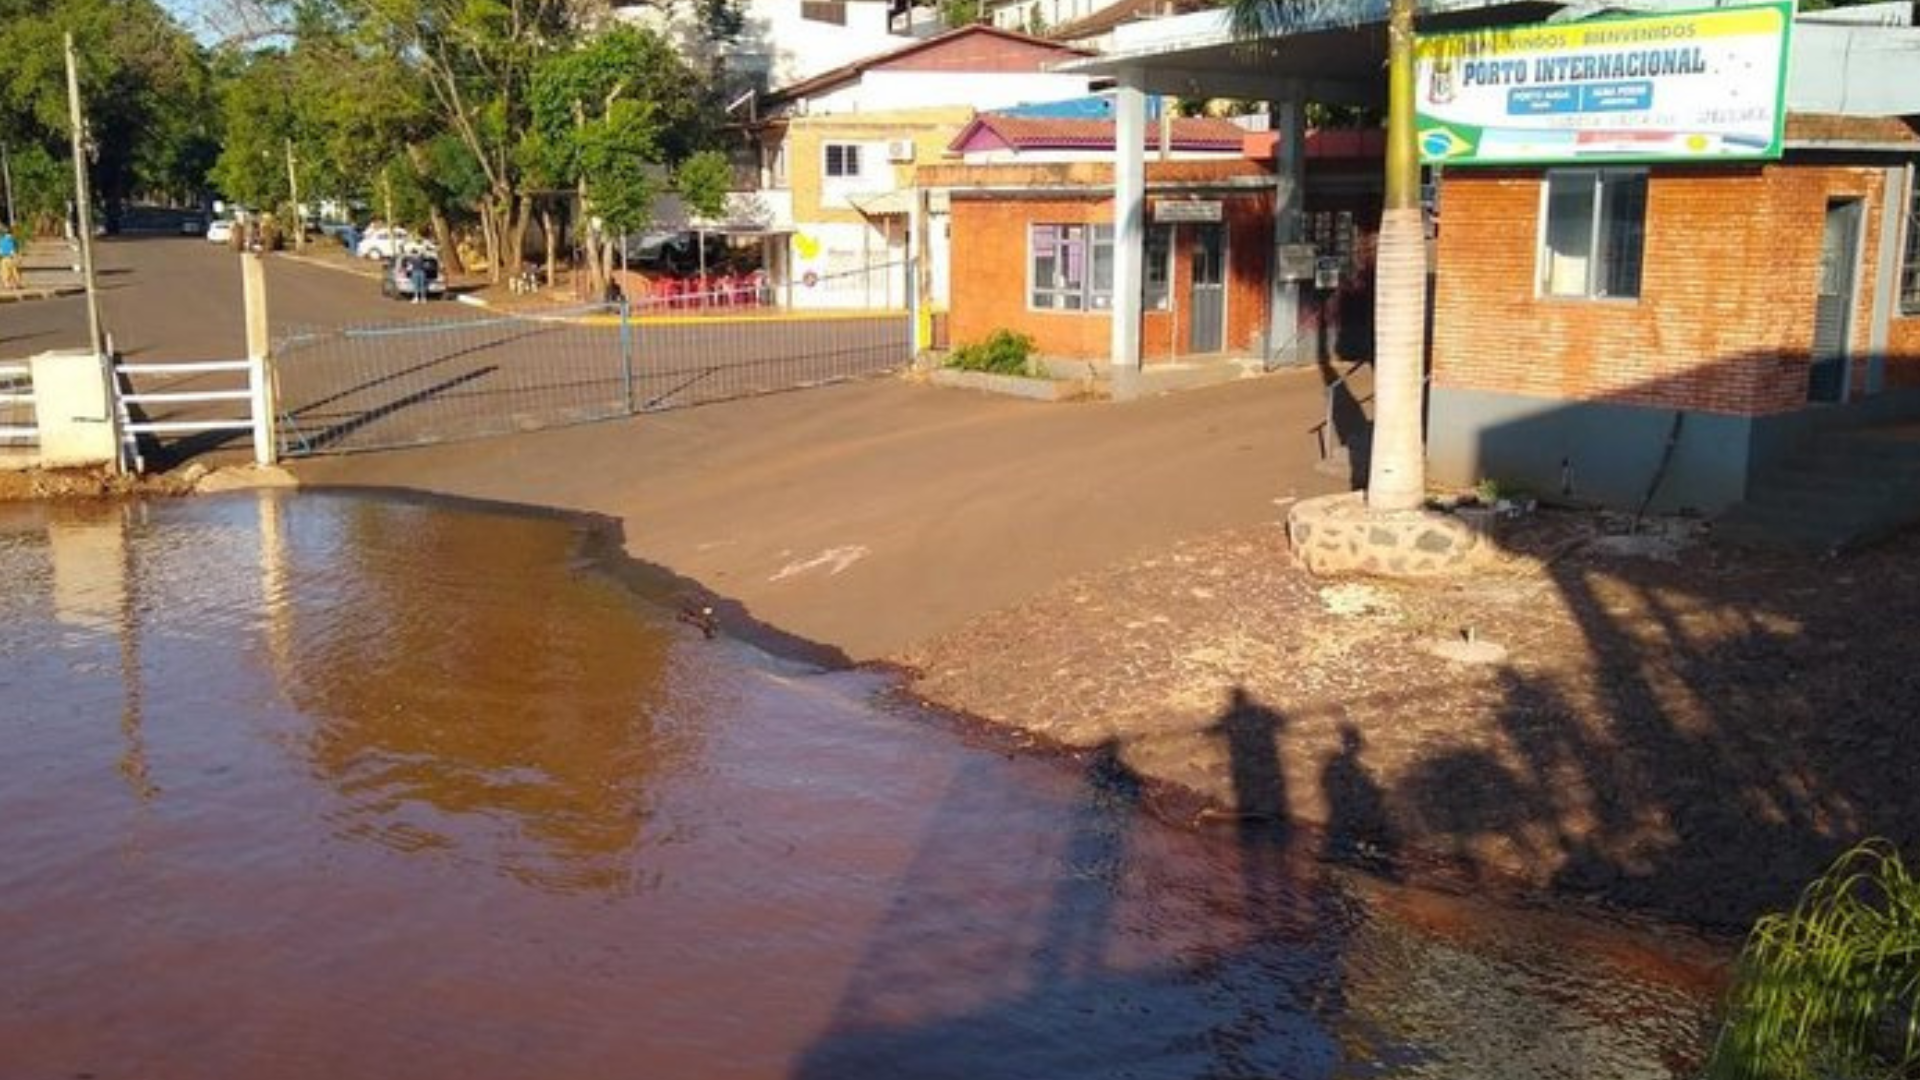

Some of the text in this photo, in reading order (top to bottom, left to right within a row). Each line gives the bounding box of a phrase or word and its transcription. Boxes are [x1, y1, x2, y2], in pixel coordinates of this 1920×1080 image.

[1584, 23, 1696, 45] BIENVENIDOS
[1463, 58, 1527, 86] PORTO
[1534, 46, 1706, 82] INTERNACIONAL
